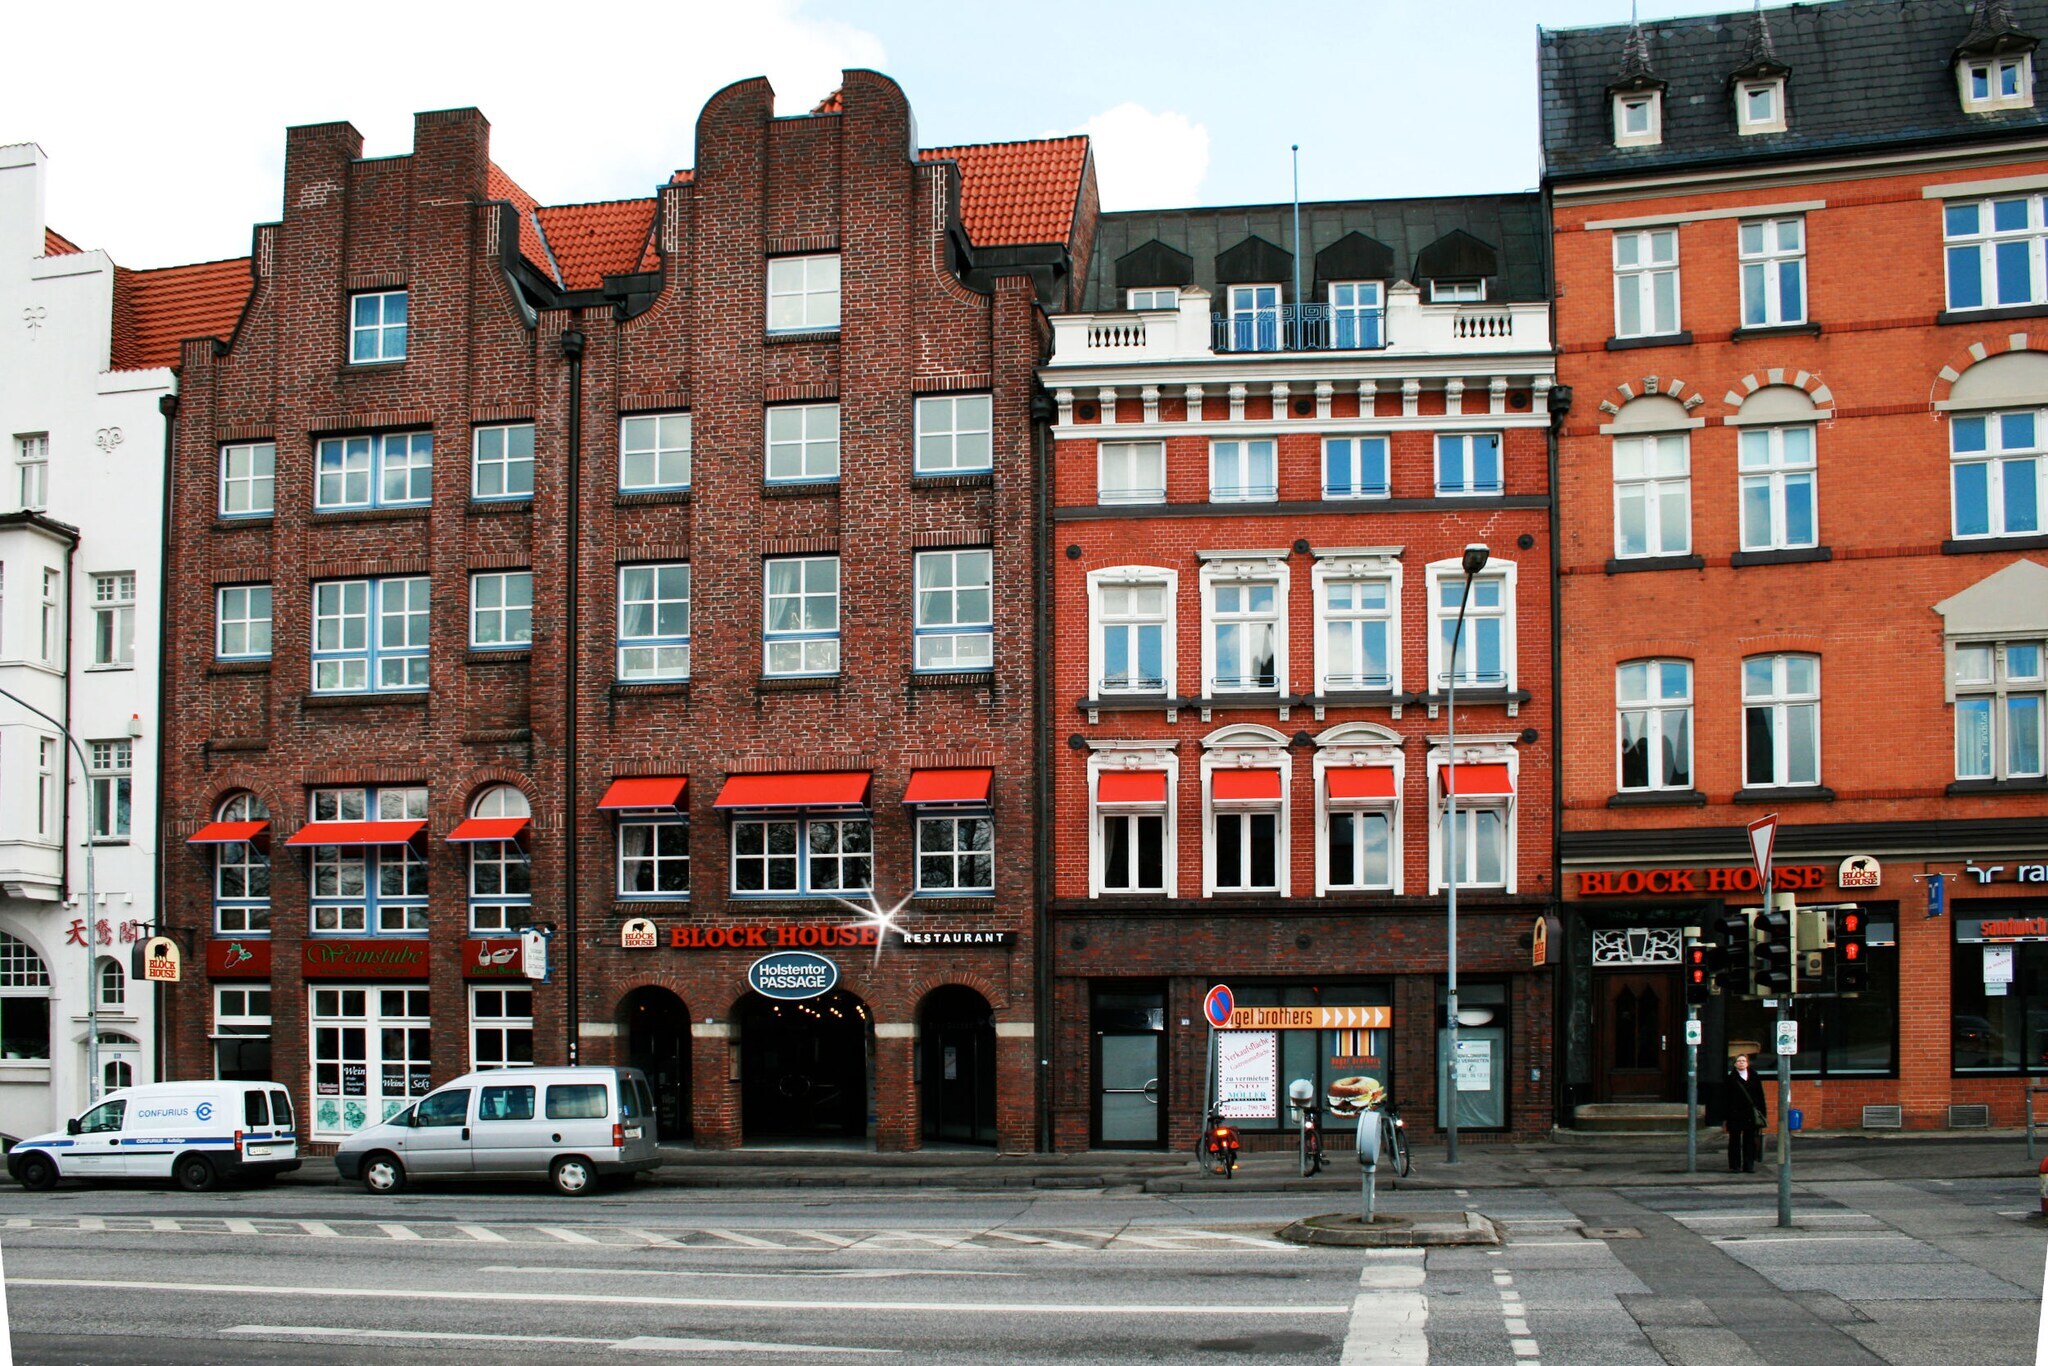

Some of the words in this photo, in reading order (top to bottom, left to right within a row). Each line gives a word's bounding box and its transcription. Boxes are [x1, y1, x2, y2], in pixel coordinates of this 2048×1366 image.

[1842, 871, 1877, 879] BLOCK
[2018, 865, 2048, 882] ra
[1578, 868, 1696, 895] BLOCK
[1842, 878, 1878, 886] HOUSE
[1981, 916, 2047, 936] sandwich
[625, 932, 654, 940] BLOCK
[671, 927, 768, 947] BLOCK
[776, 926, 880, 946] HOUSE
[903, 932, 1005, 944] RESTAURANT
[306, 943, 425, 965] Weinstube
[149, 959, 176, 970] BLOCK
[759, 963, 827, 976] Holstentor
[149, 968, 177, 979] HOUSE
[759, 975, 827, 989] PASSAGE
[1258, 1007, 1313, 1025] brothers
[344, 1066, 366, 1076] Wein
[382, 1078, 405, 1088] Weine
[410, 1078, 430, 1090] Sekt
[138, 1108, 189, 1118] CONFURIUS
